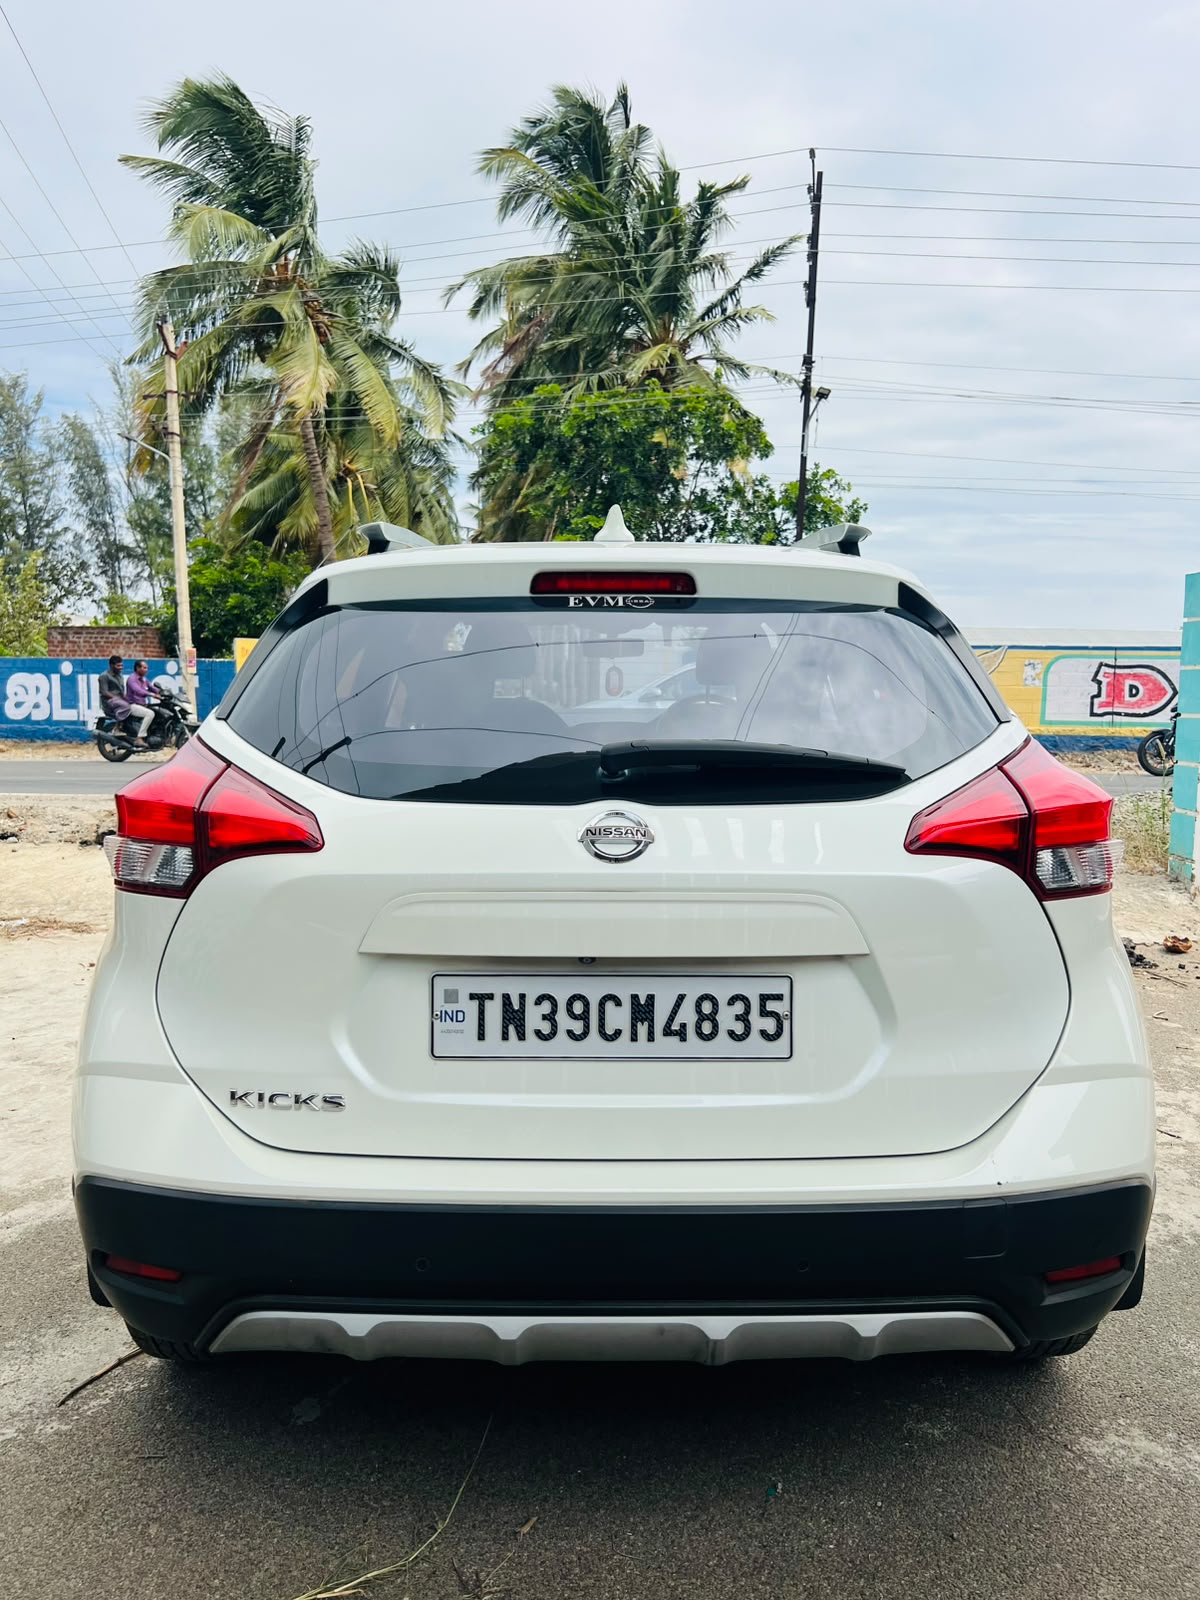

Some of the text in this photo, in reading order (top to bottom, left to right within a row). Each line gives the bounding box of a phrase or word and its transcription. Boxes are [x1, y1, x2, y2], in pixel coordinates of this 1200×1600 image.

[568, 596, 624, 607] EVM
[586, 827, 647, 838] NISSAN
[440, 1010, 465, 1023] IND
[469, 992, 784, 1042] TN39CM4835
[230, 1089, 345, 1112] KICKS
